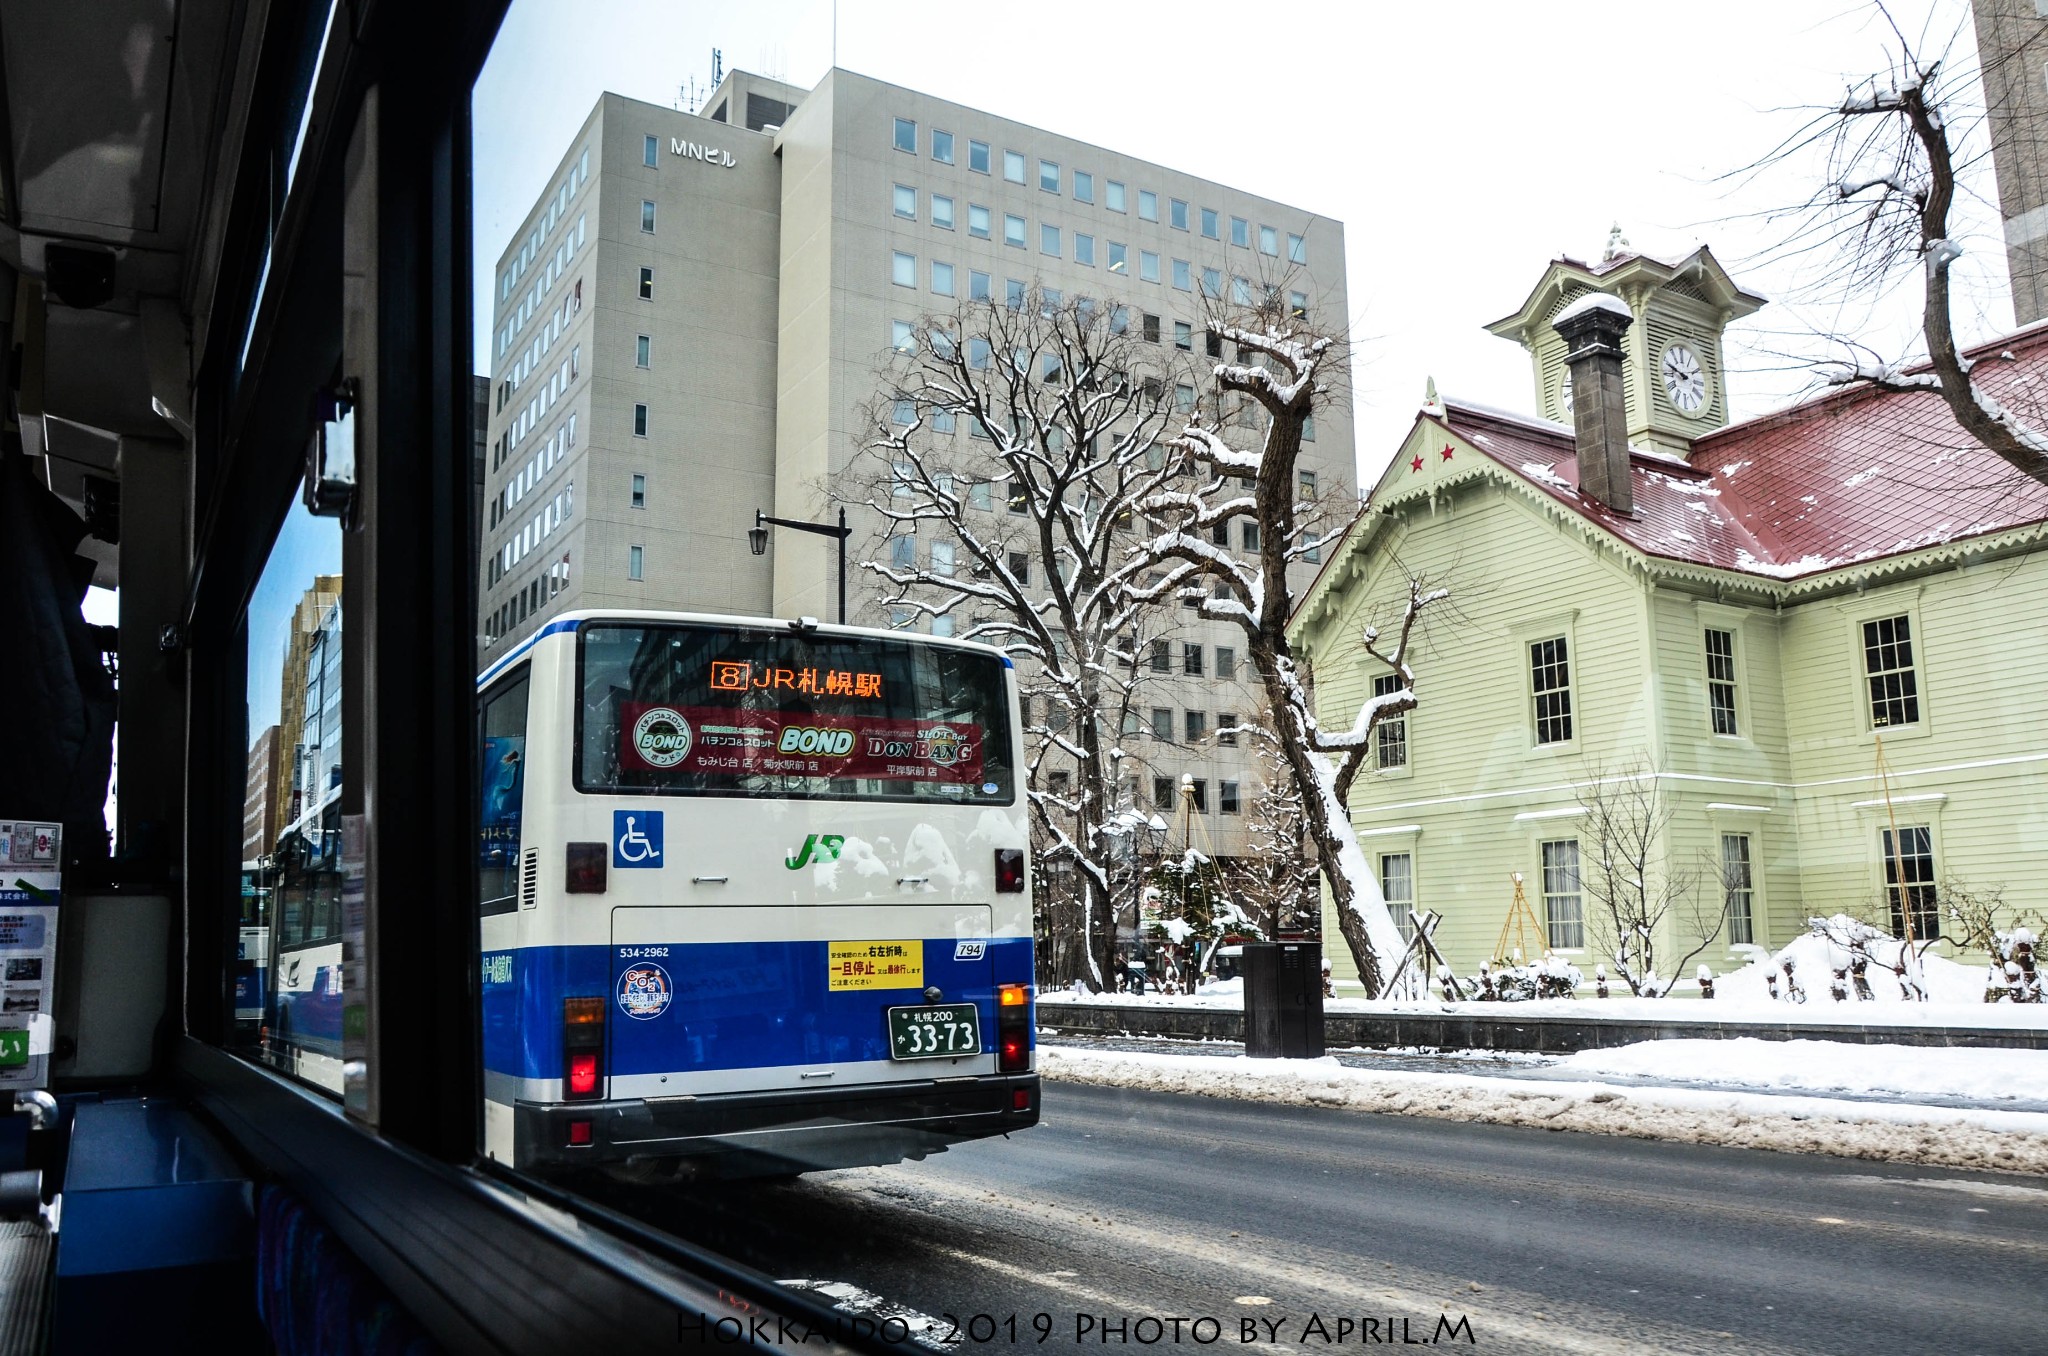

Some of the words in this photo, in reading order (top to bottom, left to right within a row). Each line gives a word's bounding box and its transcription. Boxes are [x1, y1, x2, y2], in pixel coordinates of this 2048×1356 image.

[671, 137, 736, 168] MNビル
[720, 666, 740, 687] 8
[753, 667, 882, 698] JR札幌駅
[917, 729, 949, 740] SLOT
[640, 733, 687, 750] BOND
[701, 736, 776, 748] パチンコ&スロット
[778, 726, 855, 756] BOND
[651, 754, 675, 764] ボンド
[697, 756, 738, 768] もみじ台
[742, 758, 753, 769] 店
[808, 761, 818, 771] 店
[927, 767, 938, 777] 店
[620, 947, 669, 958] 534-2962
[960, 945, 980, 955] 794
[831, 979, 872, 987] ご注意ください
[897, 1035, 906, 1044] か
[908, 1022, 974, 1052] 33-73
